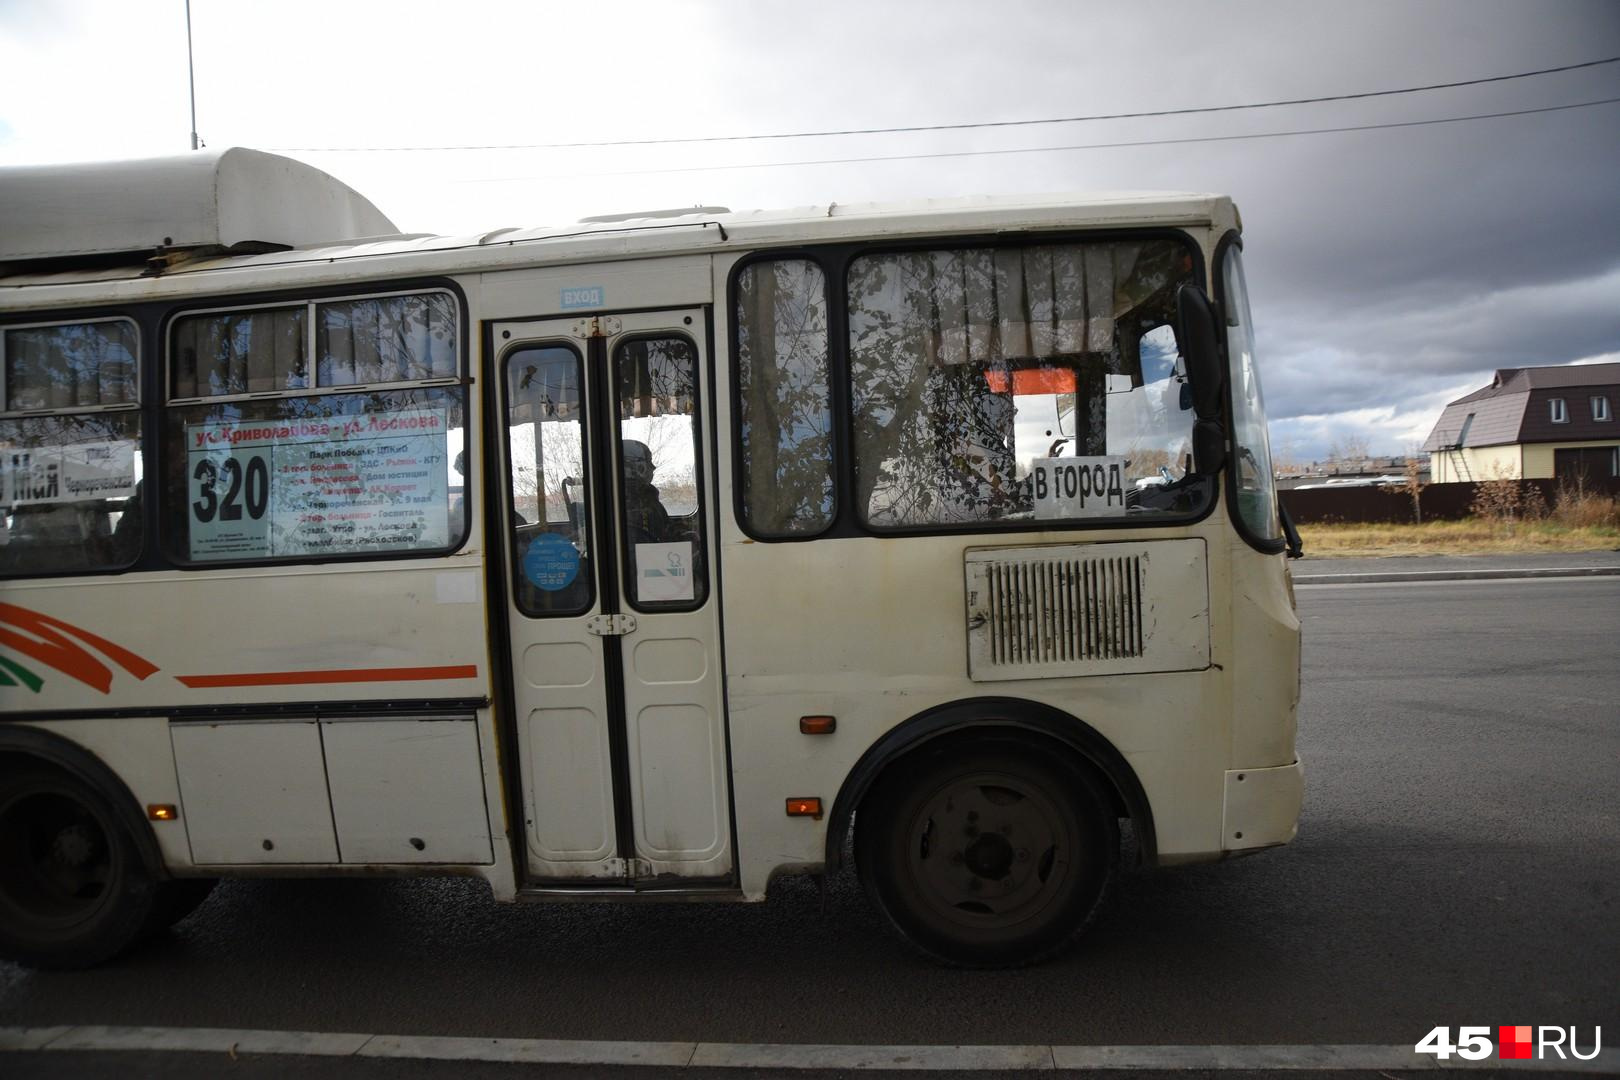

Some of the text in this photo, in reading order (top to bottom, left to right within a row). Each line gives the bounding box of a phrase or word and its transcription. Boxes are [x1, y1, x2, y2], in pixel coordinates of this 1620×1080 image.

[564, 289, 600, 305] ВХОД
[193, 455, 269, 524] 320
[1035, 463, 1124, 509] в город
